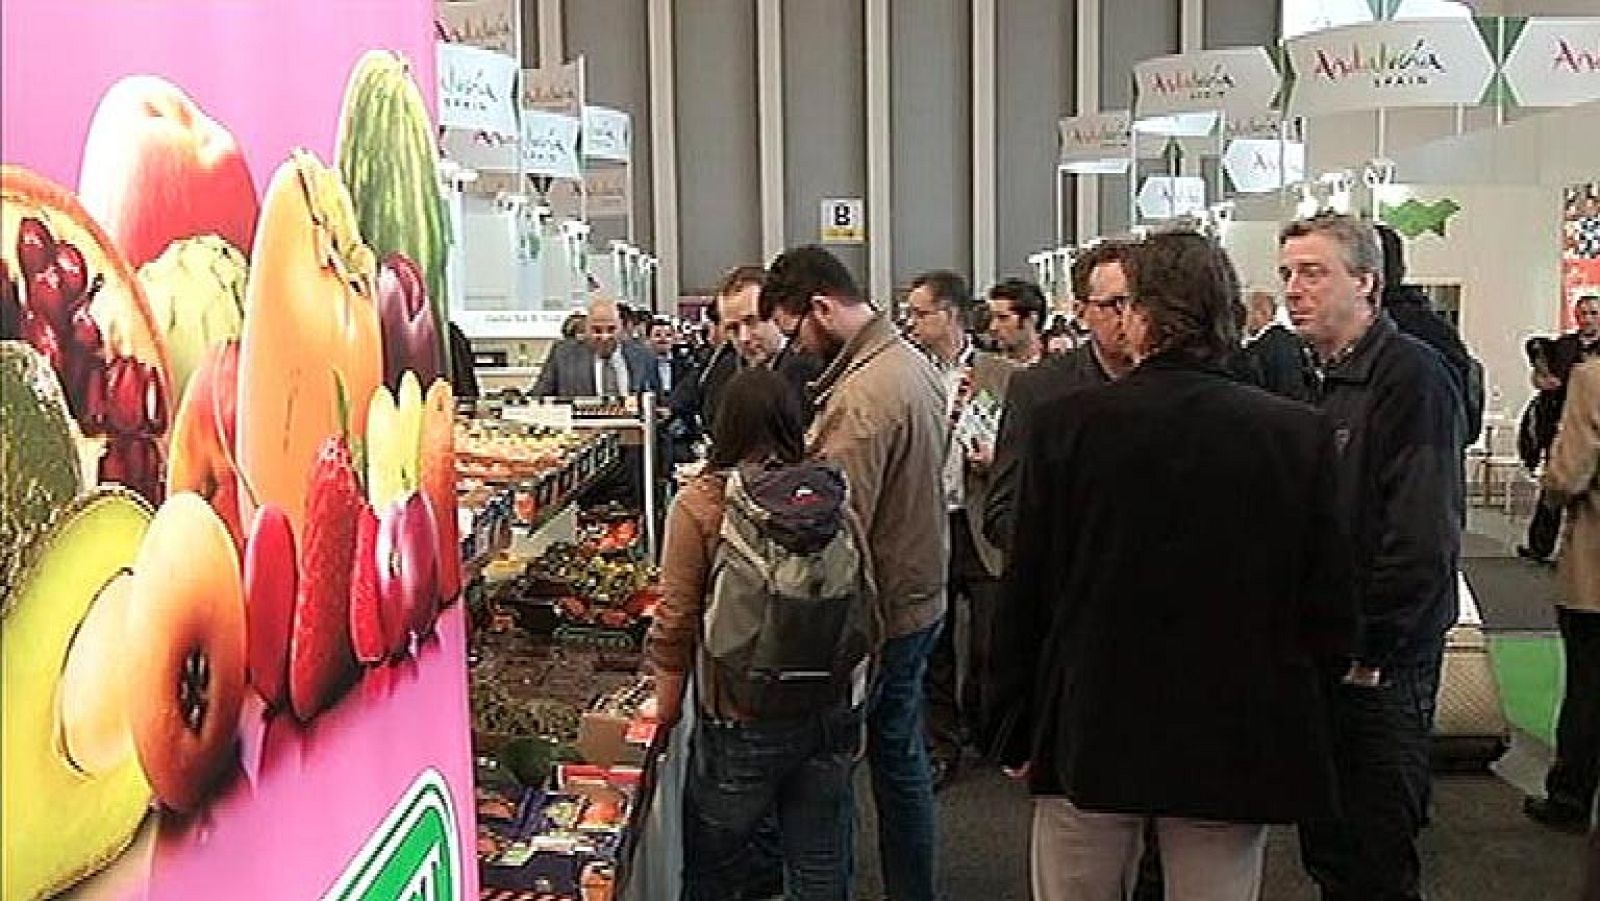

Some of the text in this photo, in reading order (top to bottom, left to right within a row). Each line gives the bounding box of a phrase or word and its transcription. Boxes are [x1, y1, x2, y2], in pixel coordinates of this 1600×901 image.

[1314, 38, 1446, 79] Andalucía
[1373, 77, 1427, 88] SPAIN
[835, 203, 850, 225] B
